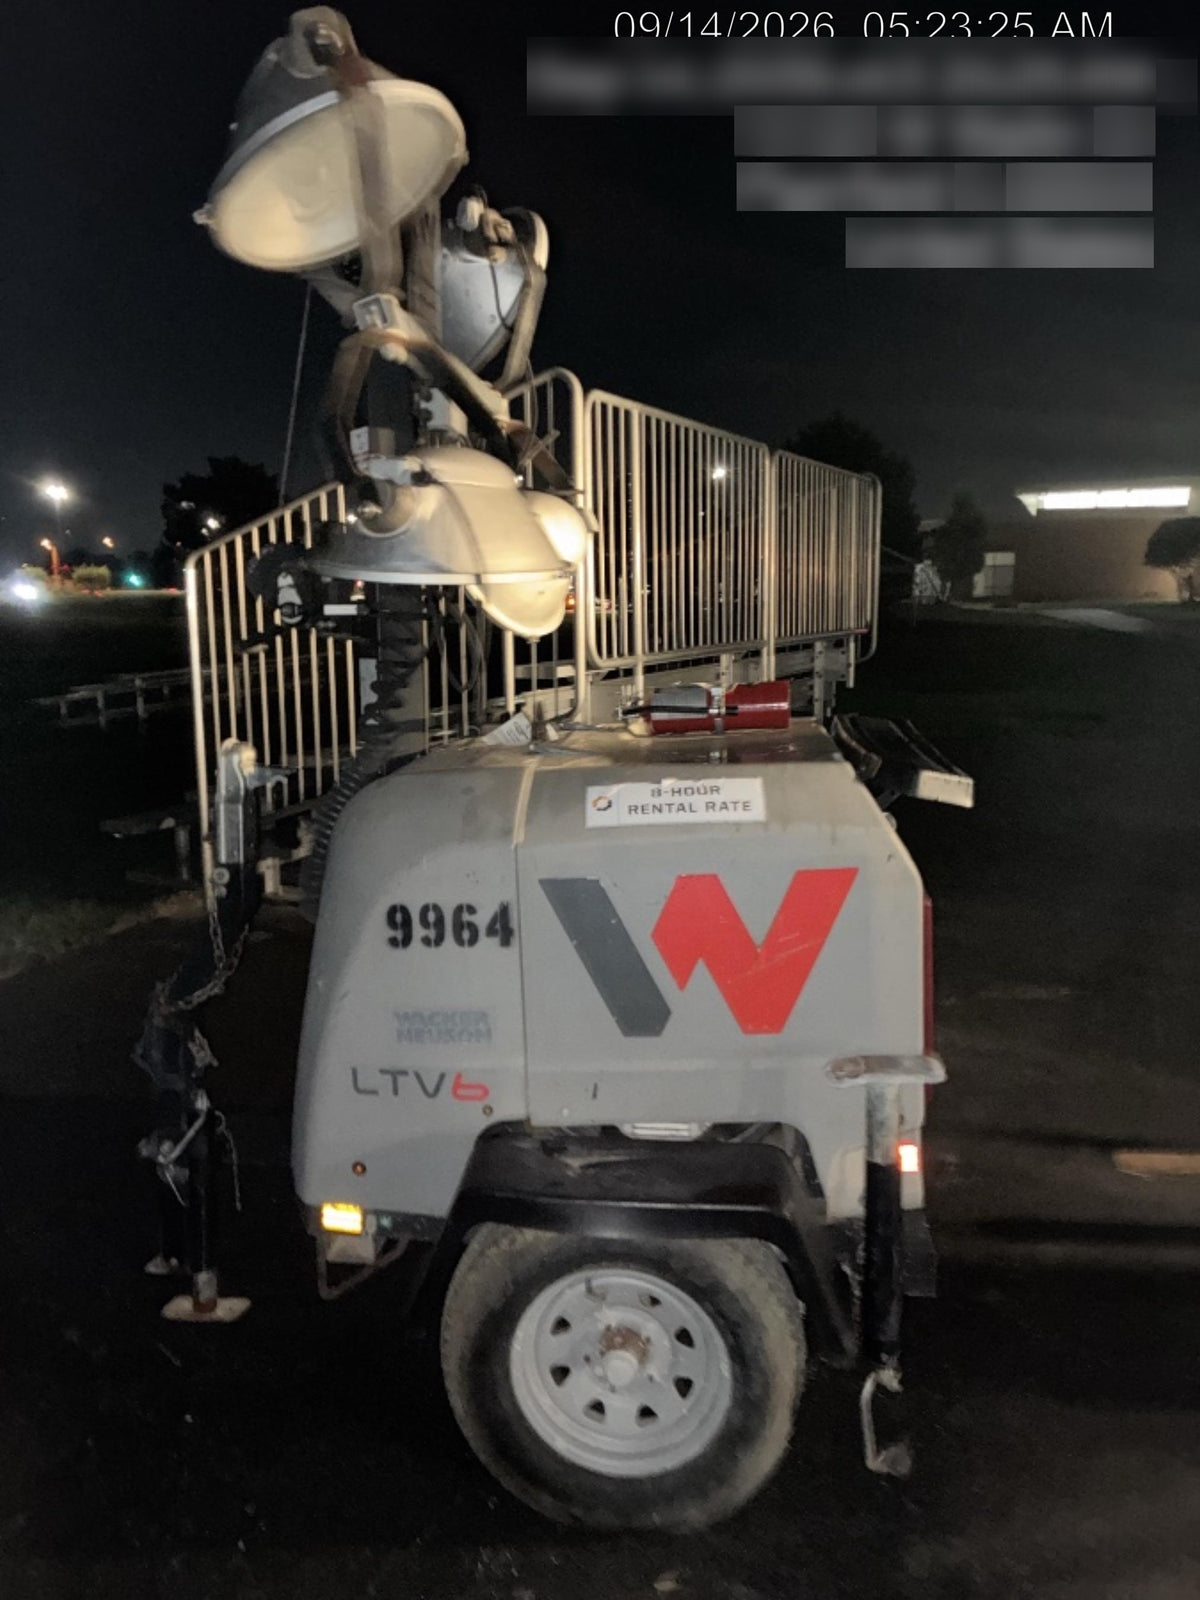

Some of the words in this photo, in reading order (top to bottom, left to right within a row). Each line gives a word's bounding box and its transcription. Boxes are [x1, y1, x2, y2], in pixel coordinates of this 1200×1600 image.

[628, 803, 697, 816] RENTAL
[705, 800, 753, 812] RATE
[386, 902, 515, 949] 9964
[352, 1067, 489, 1101] LTV6
